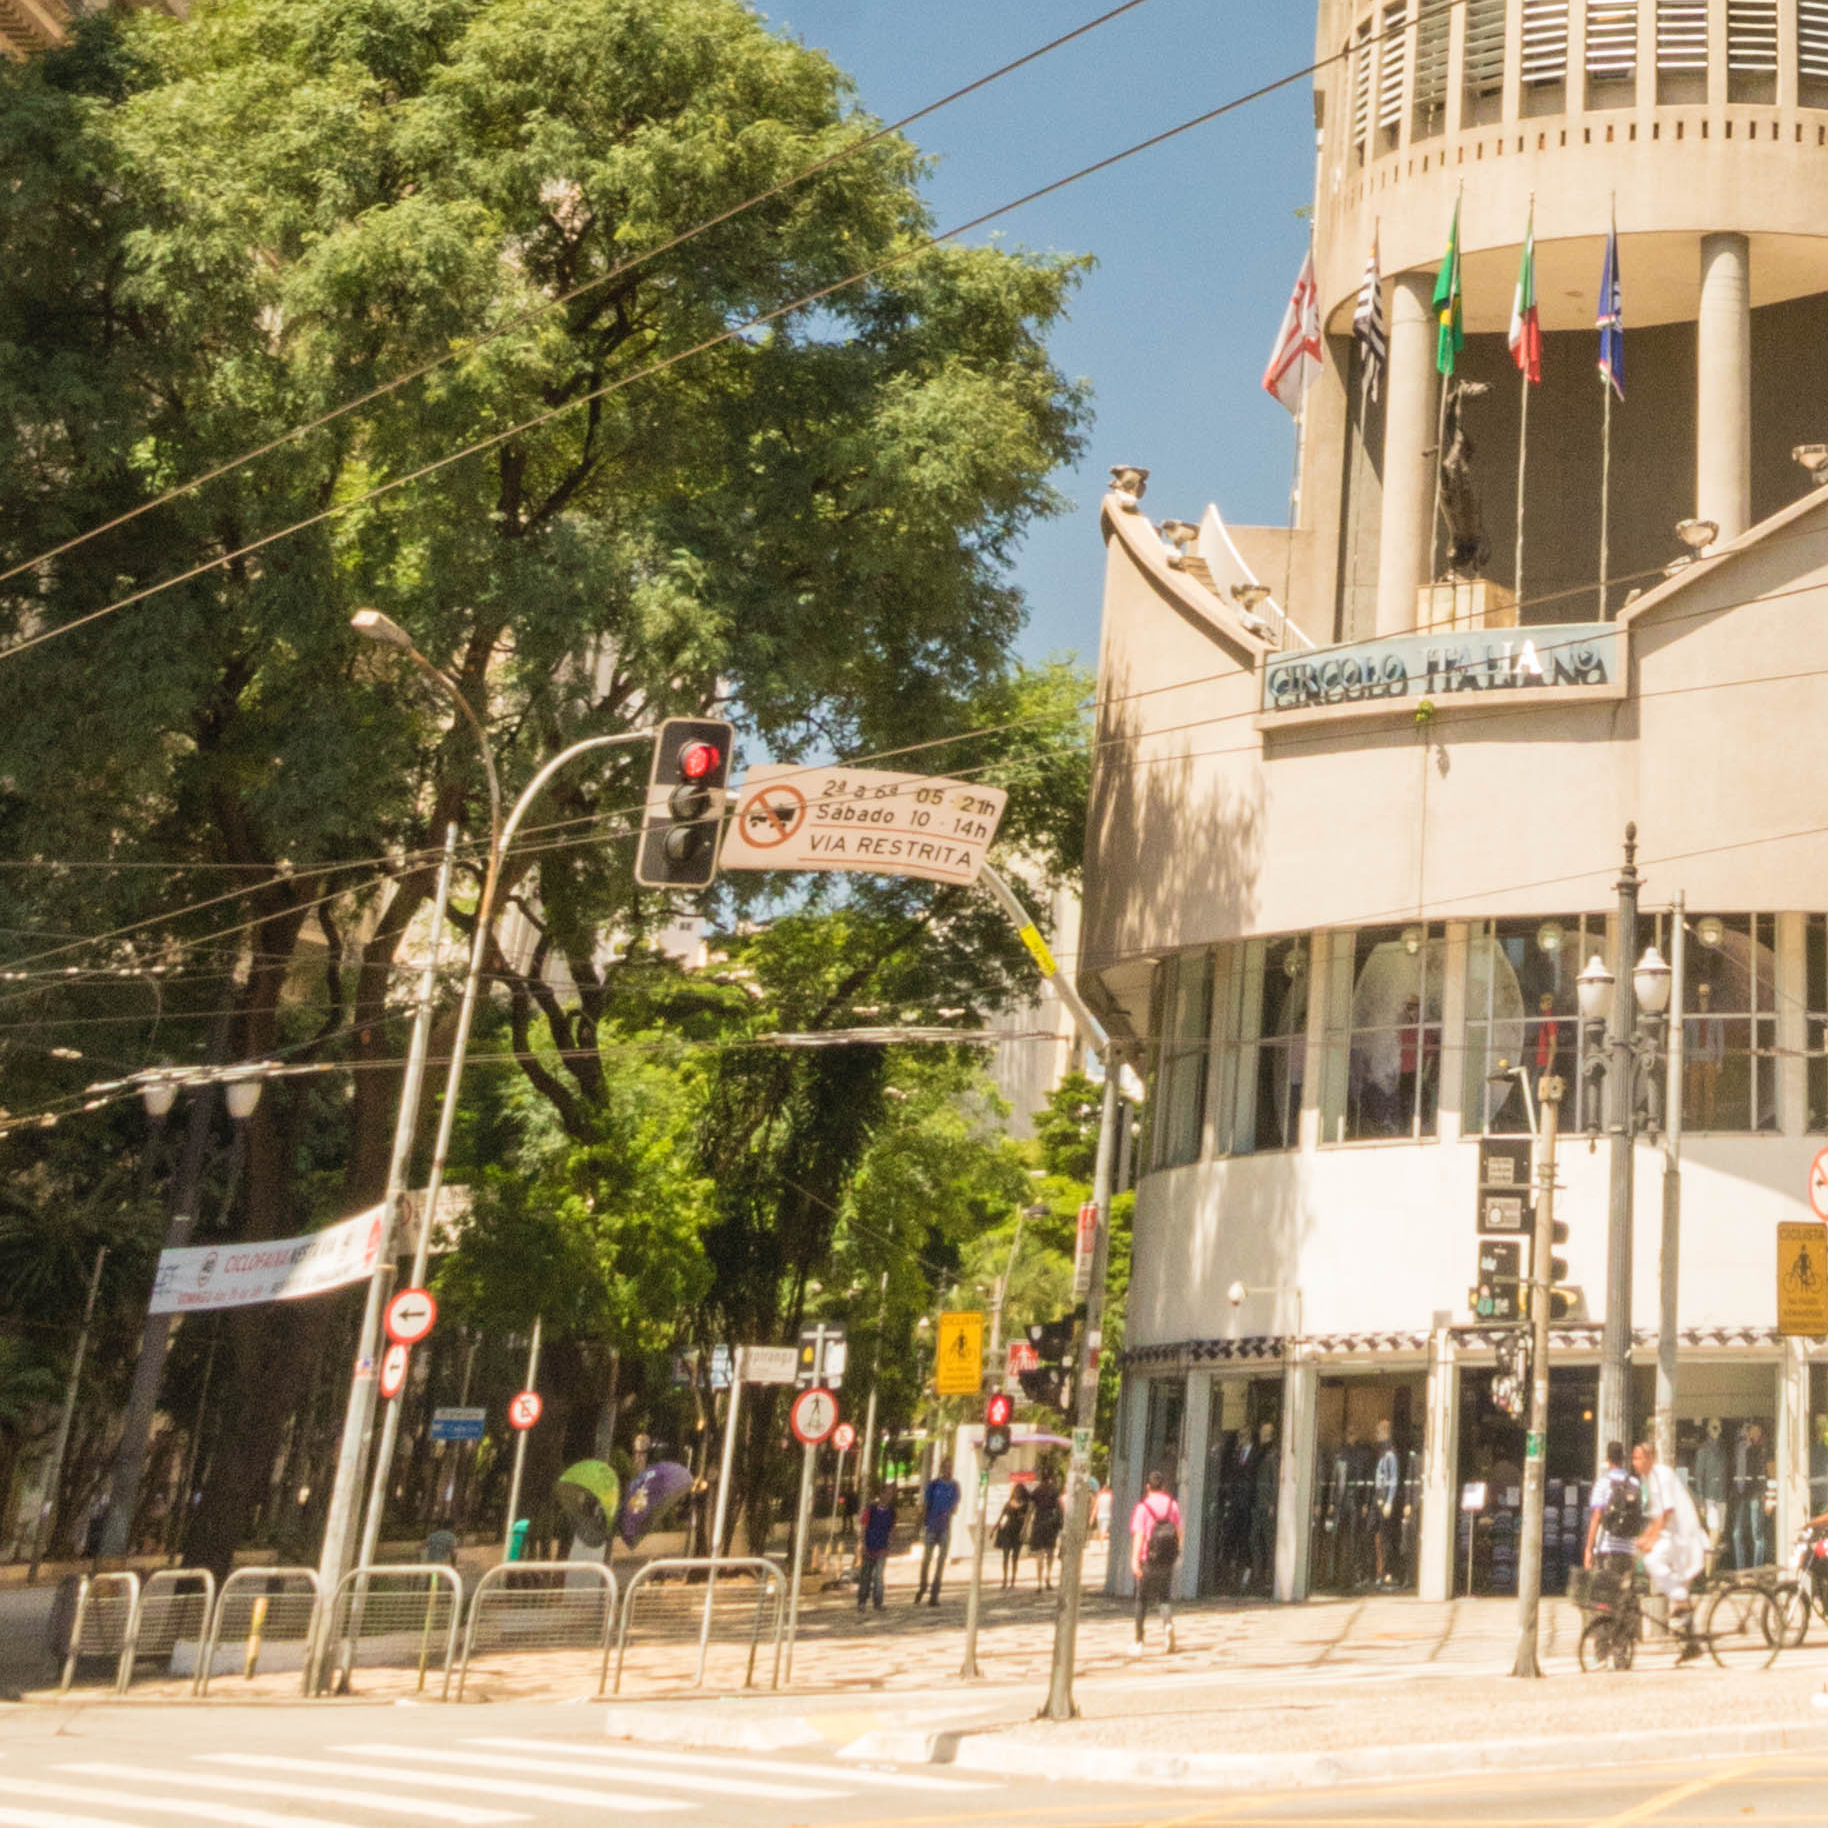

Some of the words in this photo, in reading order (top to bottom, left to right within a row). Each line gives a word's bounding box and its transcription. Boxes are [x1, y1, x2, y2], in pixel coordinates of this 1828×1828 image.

[1268, 653, 1406, 699] CIRCOLO
[1425, 640, 1602, 685] ITALIANO
[853, 783, 867, 799] a
[915, 787, 945, 806] 05
[959, 794, 996, 817] 21h
[816, 803, 895, 824] Sábado
[910, 809, 931, 828] 10
[953, 817, 988, 840] 14h
[809, 834, 846, 854] VIA
[857, 836, 972, 868] RESTRITA
